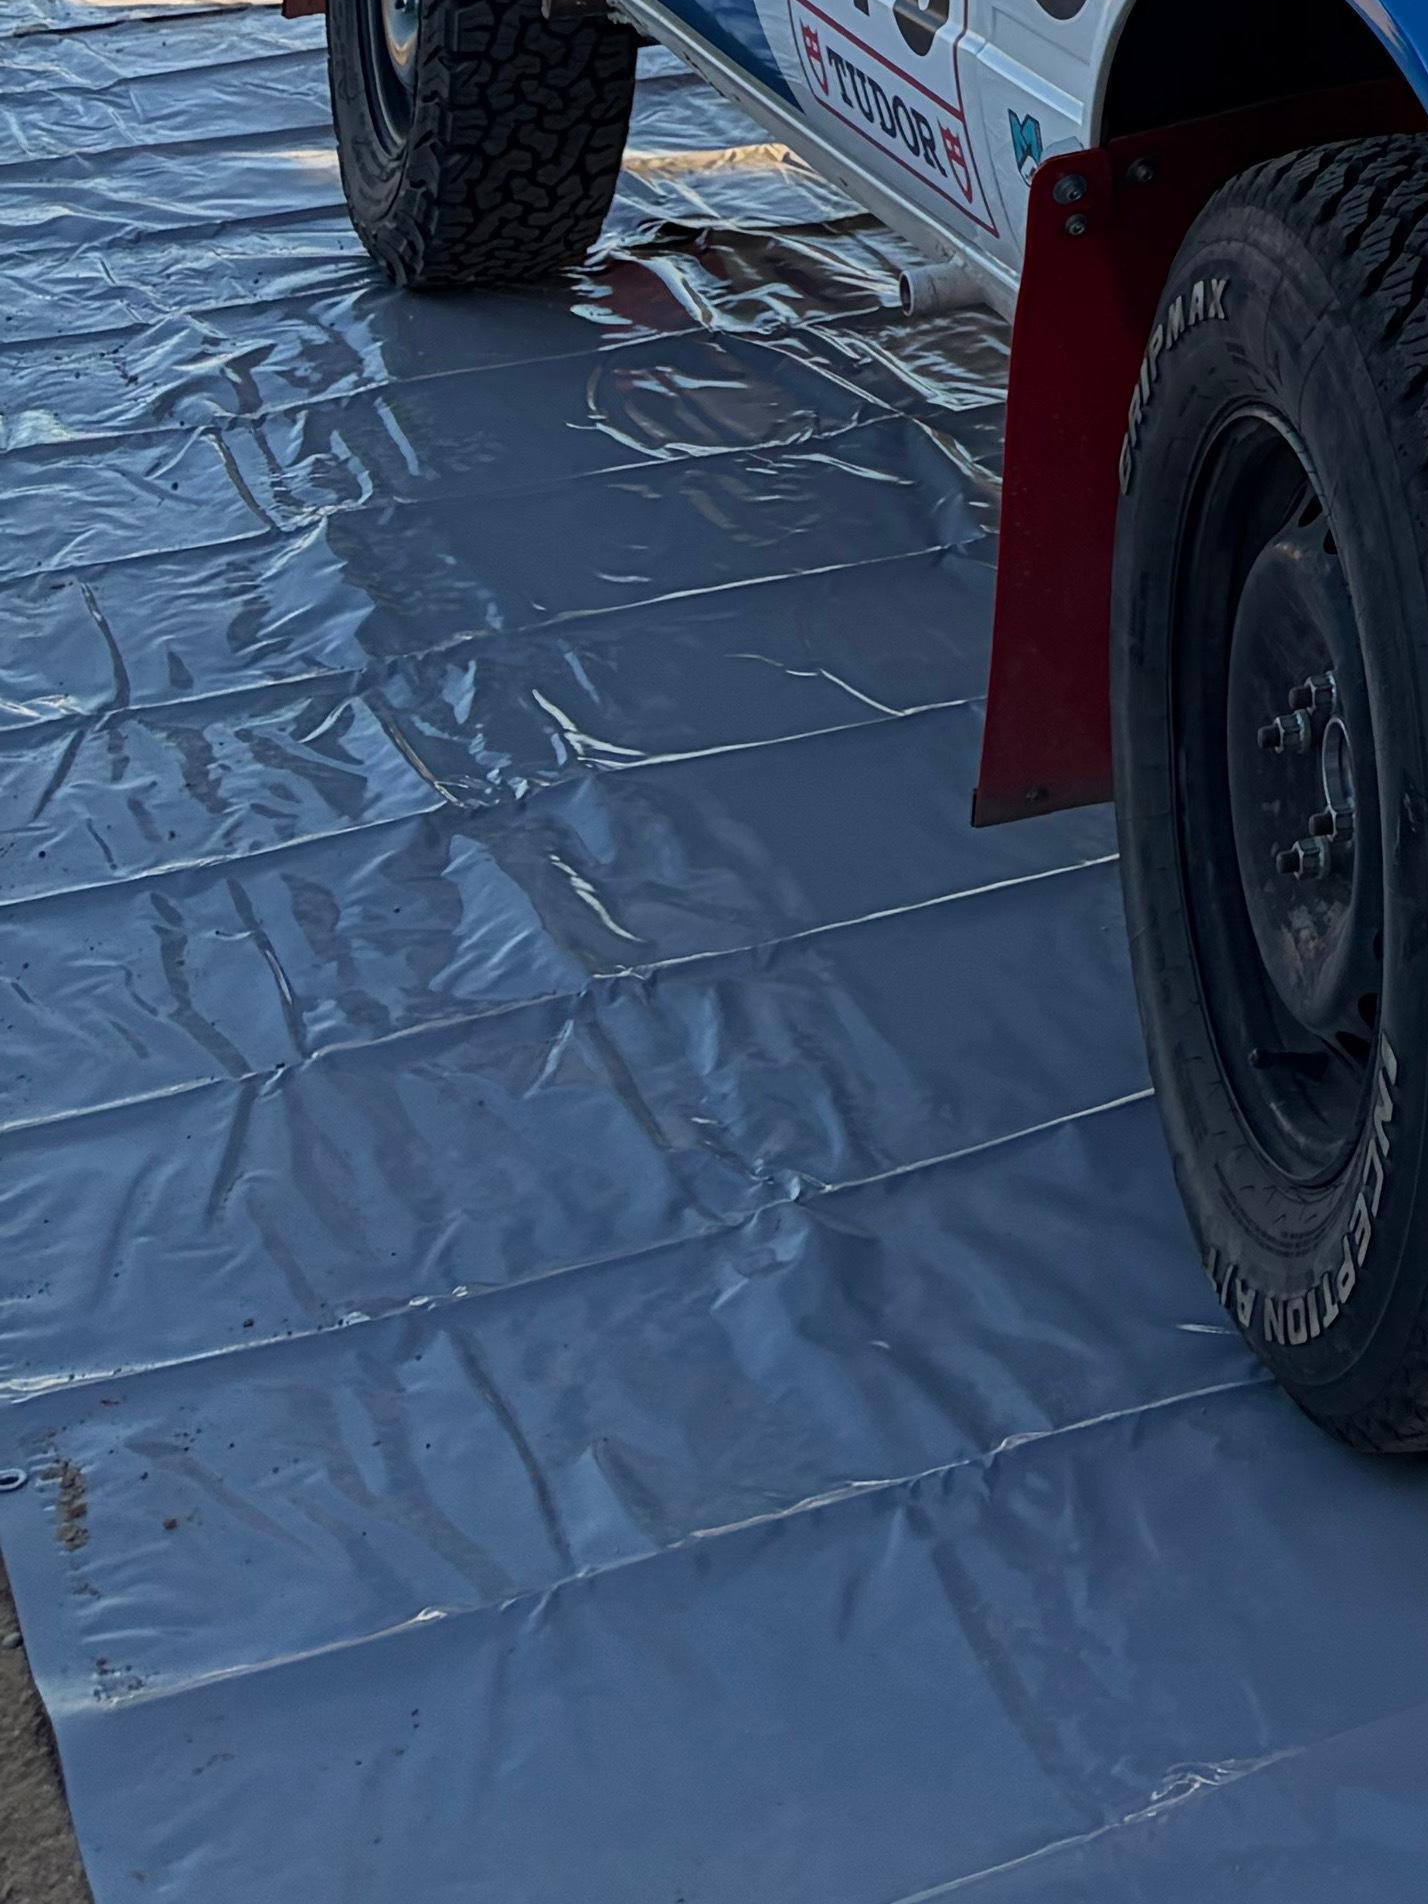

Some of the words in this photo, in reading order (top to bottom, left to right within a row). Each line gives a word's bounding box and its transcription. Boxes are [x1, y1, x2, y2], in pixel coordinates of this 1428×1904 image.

[827, 51, 949, 178] TUDOR
[1119, 277, 1230, 496] GRIPMAX
[1264, 1031, 1397, 1345] INCEPTION
